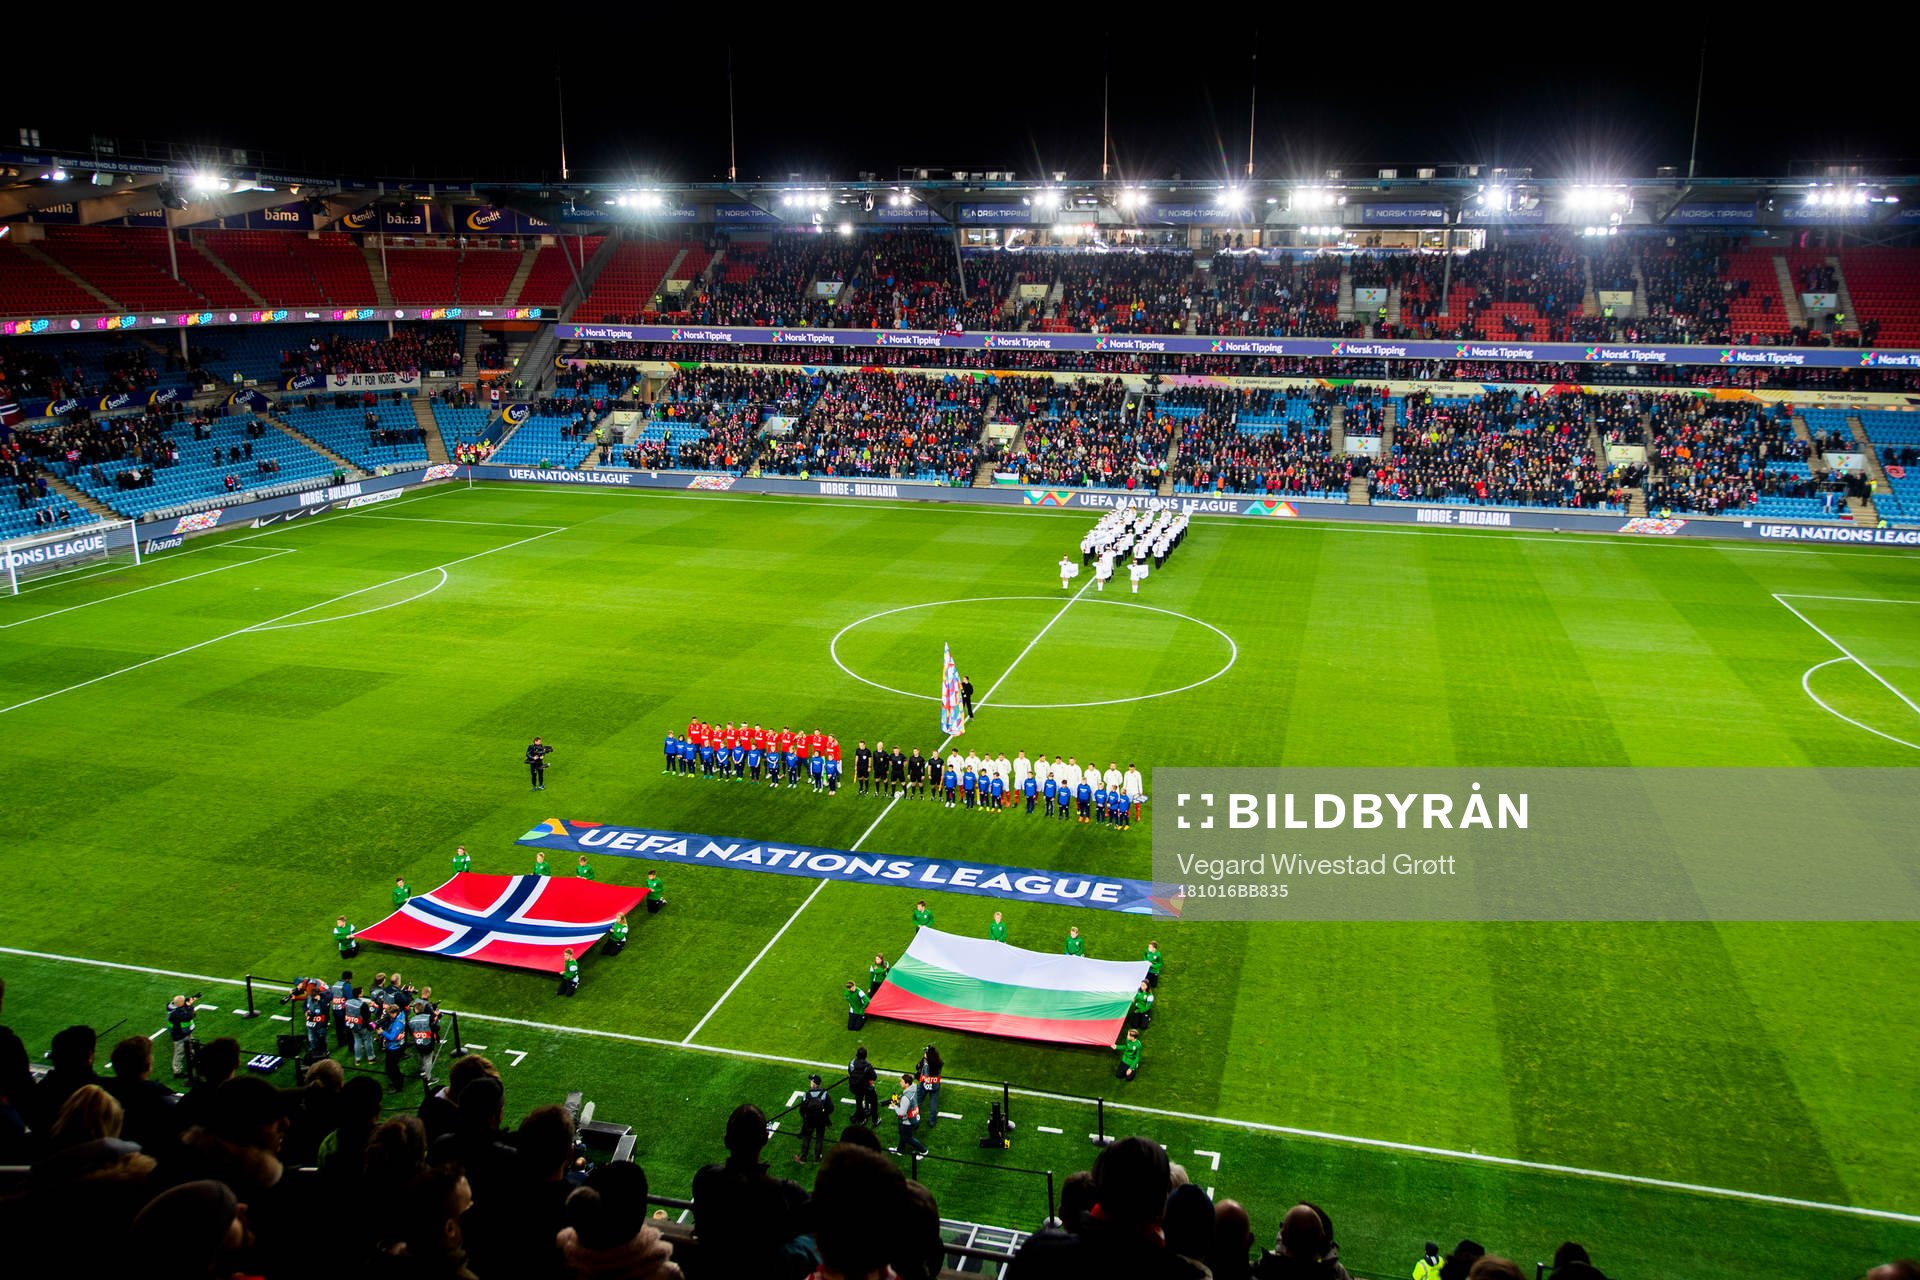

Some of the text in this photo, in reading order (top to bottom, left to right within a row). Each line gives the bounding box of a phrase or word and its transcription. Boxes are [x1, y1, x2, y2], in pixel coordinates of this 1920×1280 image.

[264, 208, 300, 222] bama
[352, 210, 376, 224] Bendit
[387, 212, 420, 224] baa
[476, 210, 501, 225] Bendit
[586, 328, 632, 339] Norsk Tipping
[684, 331, 732, 342] Norsk Tipping
[784, 334, 834, 344] Norsk Tipping
[890, 336, 940, 346] Norsk Tipping
[998, 338, 1050, 348] Norsk Tipping
[1110, 340, 1165, 350] Norsk Tipping
[1226, 342, 1283, 354] Norsk Tipping
[1346, 345, 1406, 357] Norsk Tipping
[1472, 348, 1534, 360] Norsk Tipping
[1602, 350, 1666, 362] Norsk Tipping
[1736, 352, 1804, 364] Norsk Tipping
[1878, 354, 1908, 364] Norsk
[293, 376, 316, 390] Bendit
[352, 374, 396, 386] ALT FOR NORGE
[108, 392, 130, 409] Bendit
[156, 388, 178, 403] Bendit
[54, 398, 78, 416] Bendit
[509, 468, 630, 484] UEFA NATIONS LEAGUE
[1080, 494, 1114, 506] UEFA
[1183, 500, 1238, 512] LEAGUE
[1760, 525, 1920, 544] UEFA NATIONS LEAG
[46, 536, 104, 560] LEAGUE
[150, 537, 183, 553] bama
[578, 828, 1122, 904] UEFA NATIONS LEAGUE
